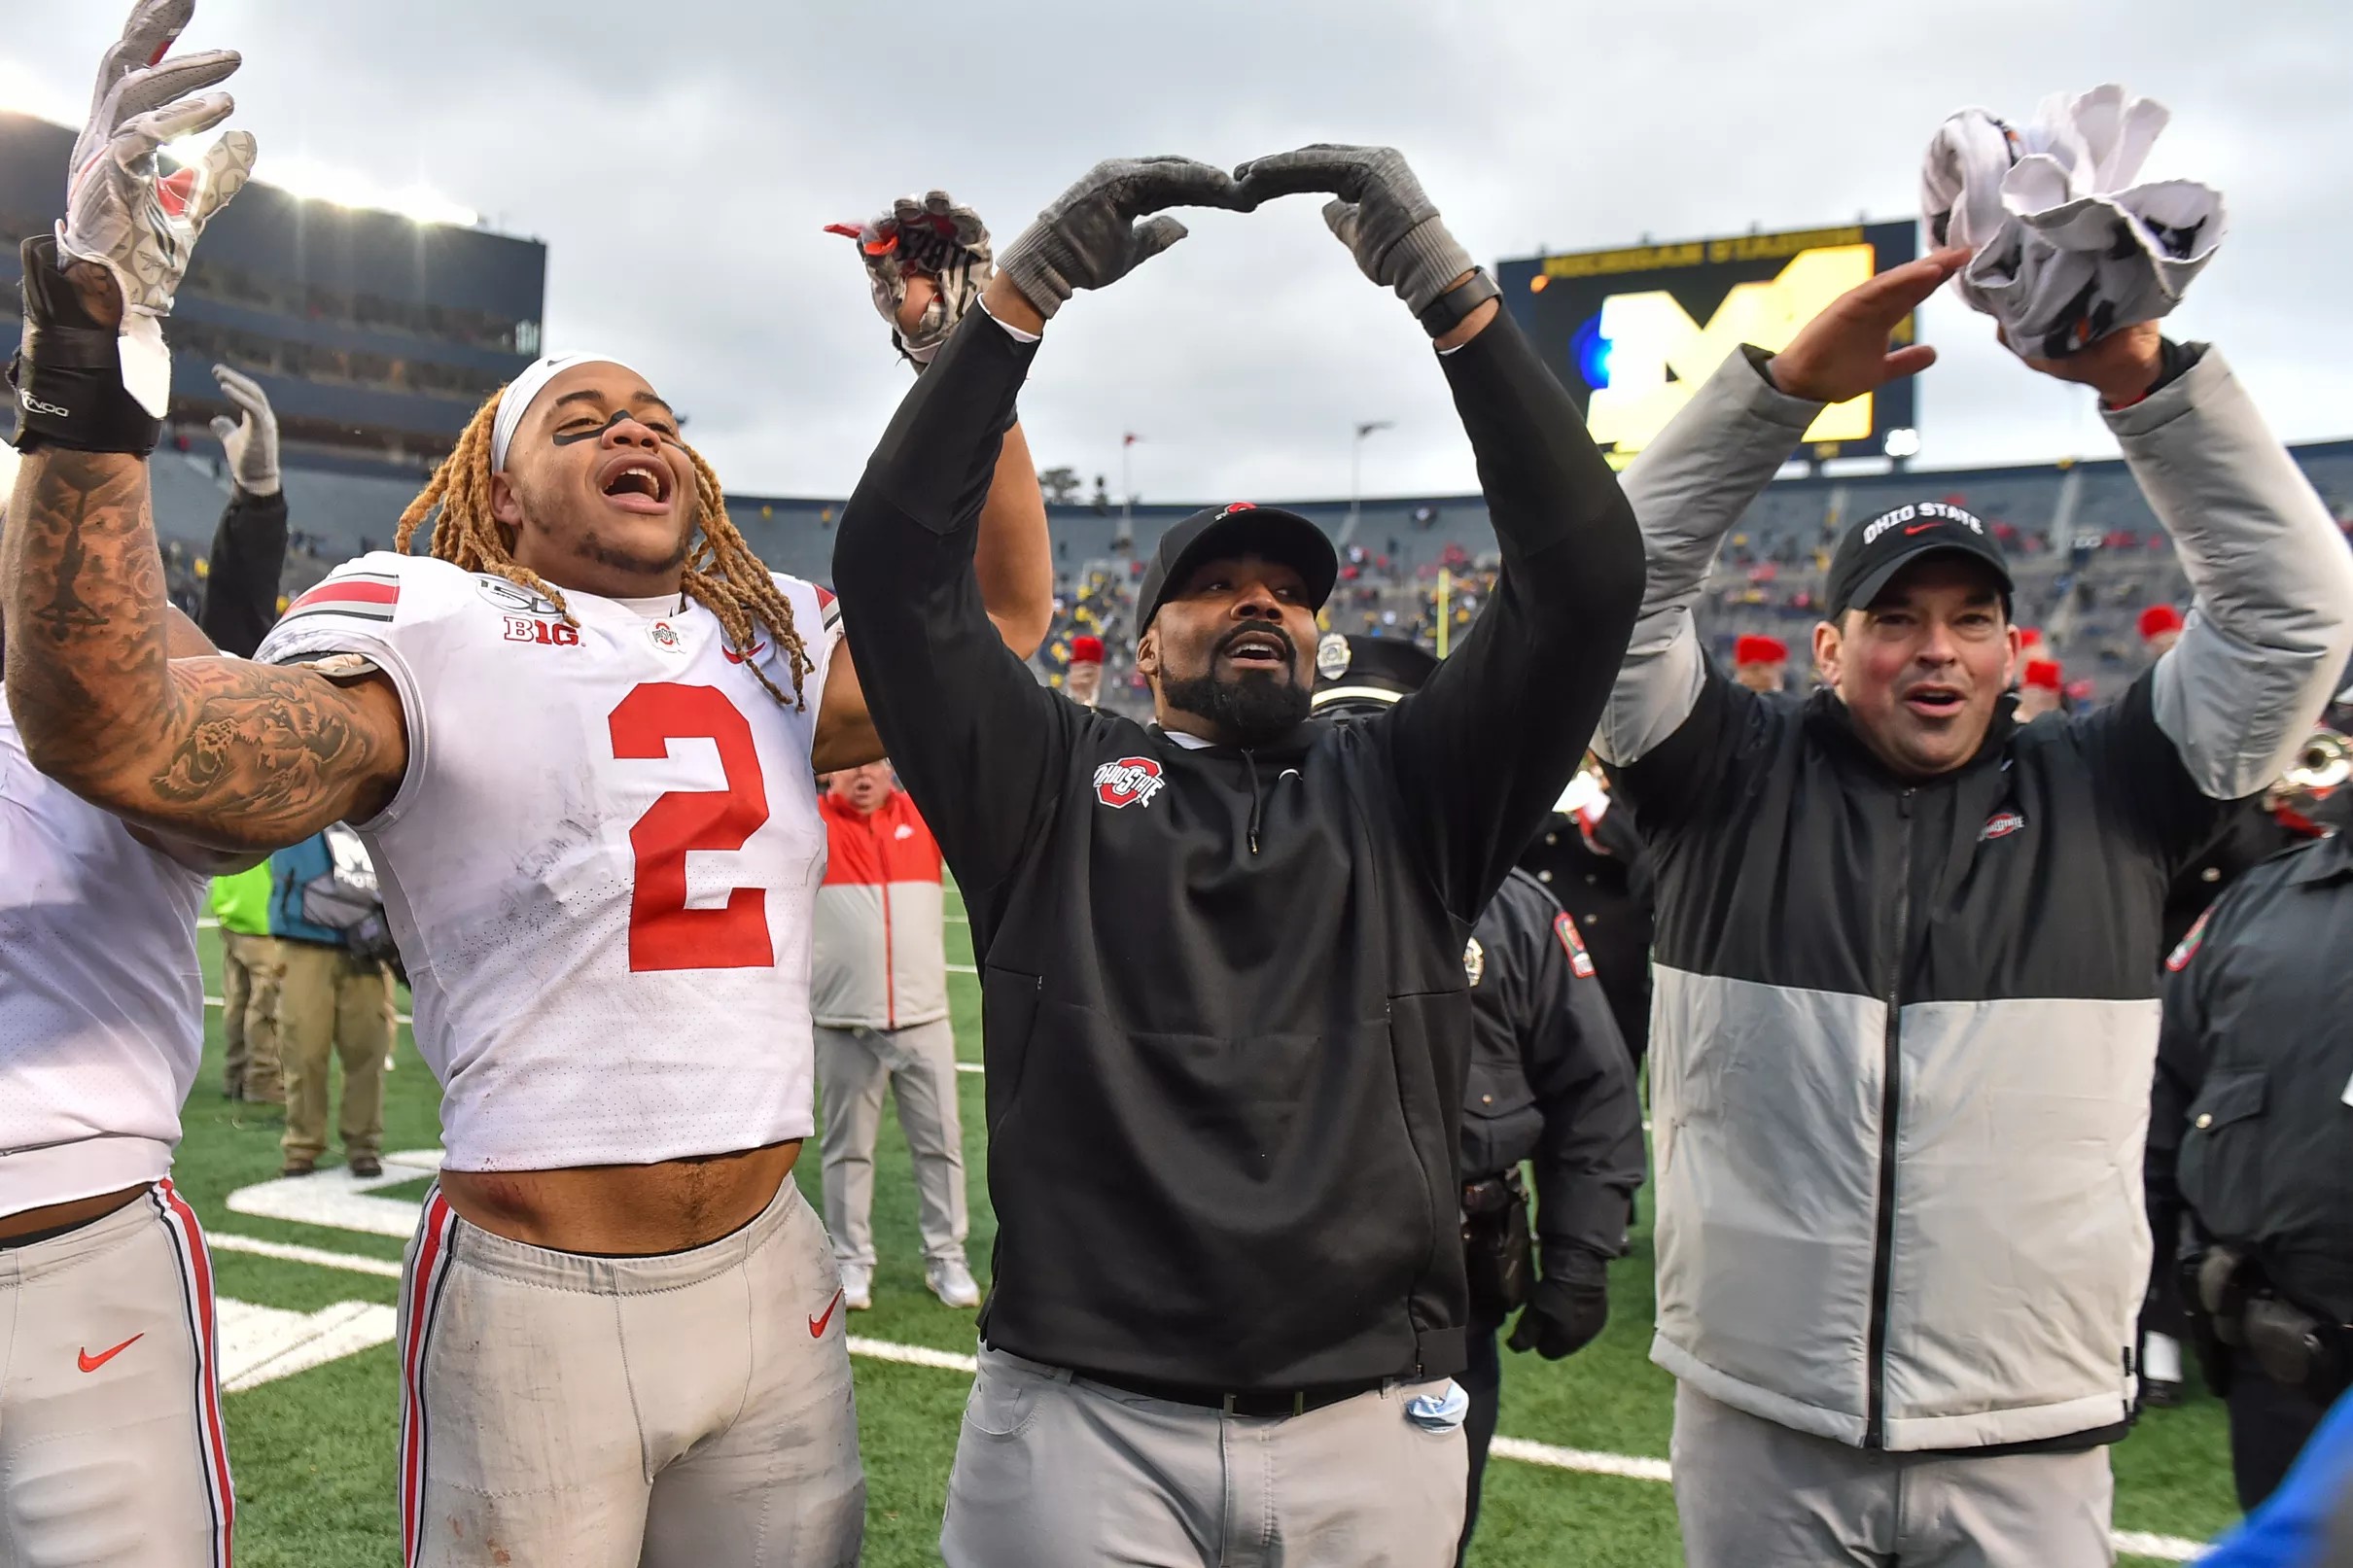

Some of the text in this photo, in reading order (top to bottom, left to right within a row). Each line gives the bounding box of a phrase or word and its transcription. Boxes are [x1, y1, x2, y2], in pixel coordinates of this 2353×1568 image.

[1863, 502, 1984, 544] OHIO STATE
[608, 681, 775, 972] 2
